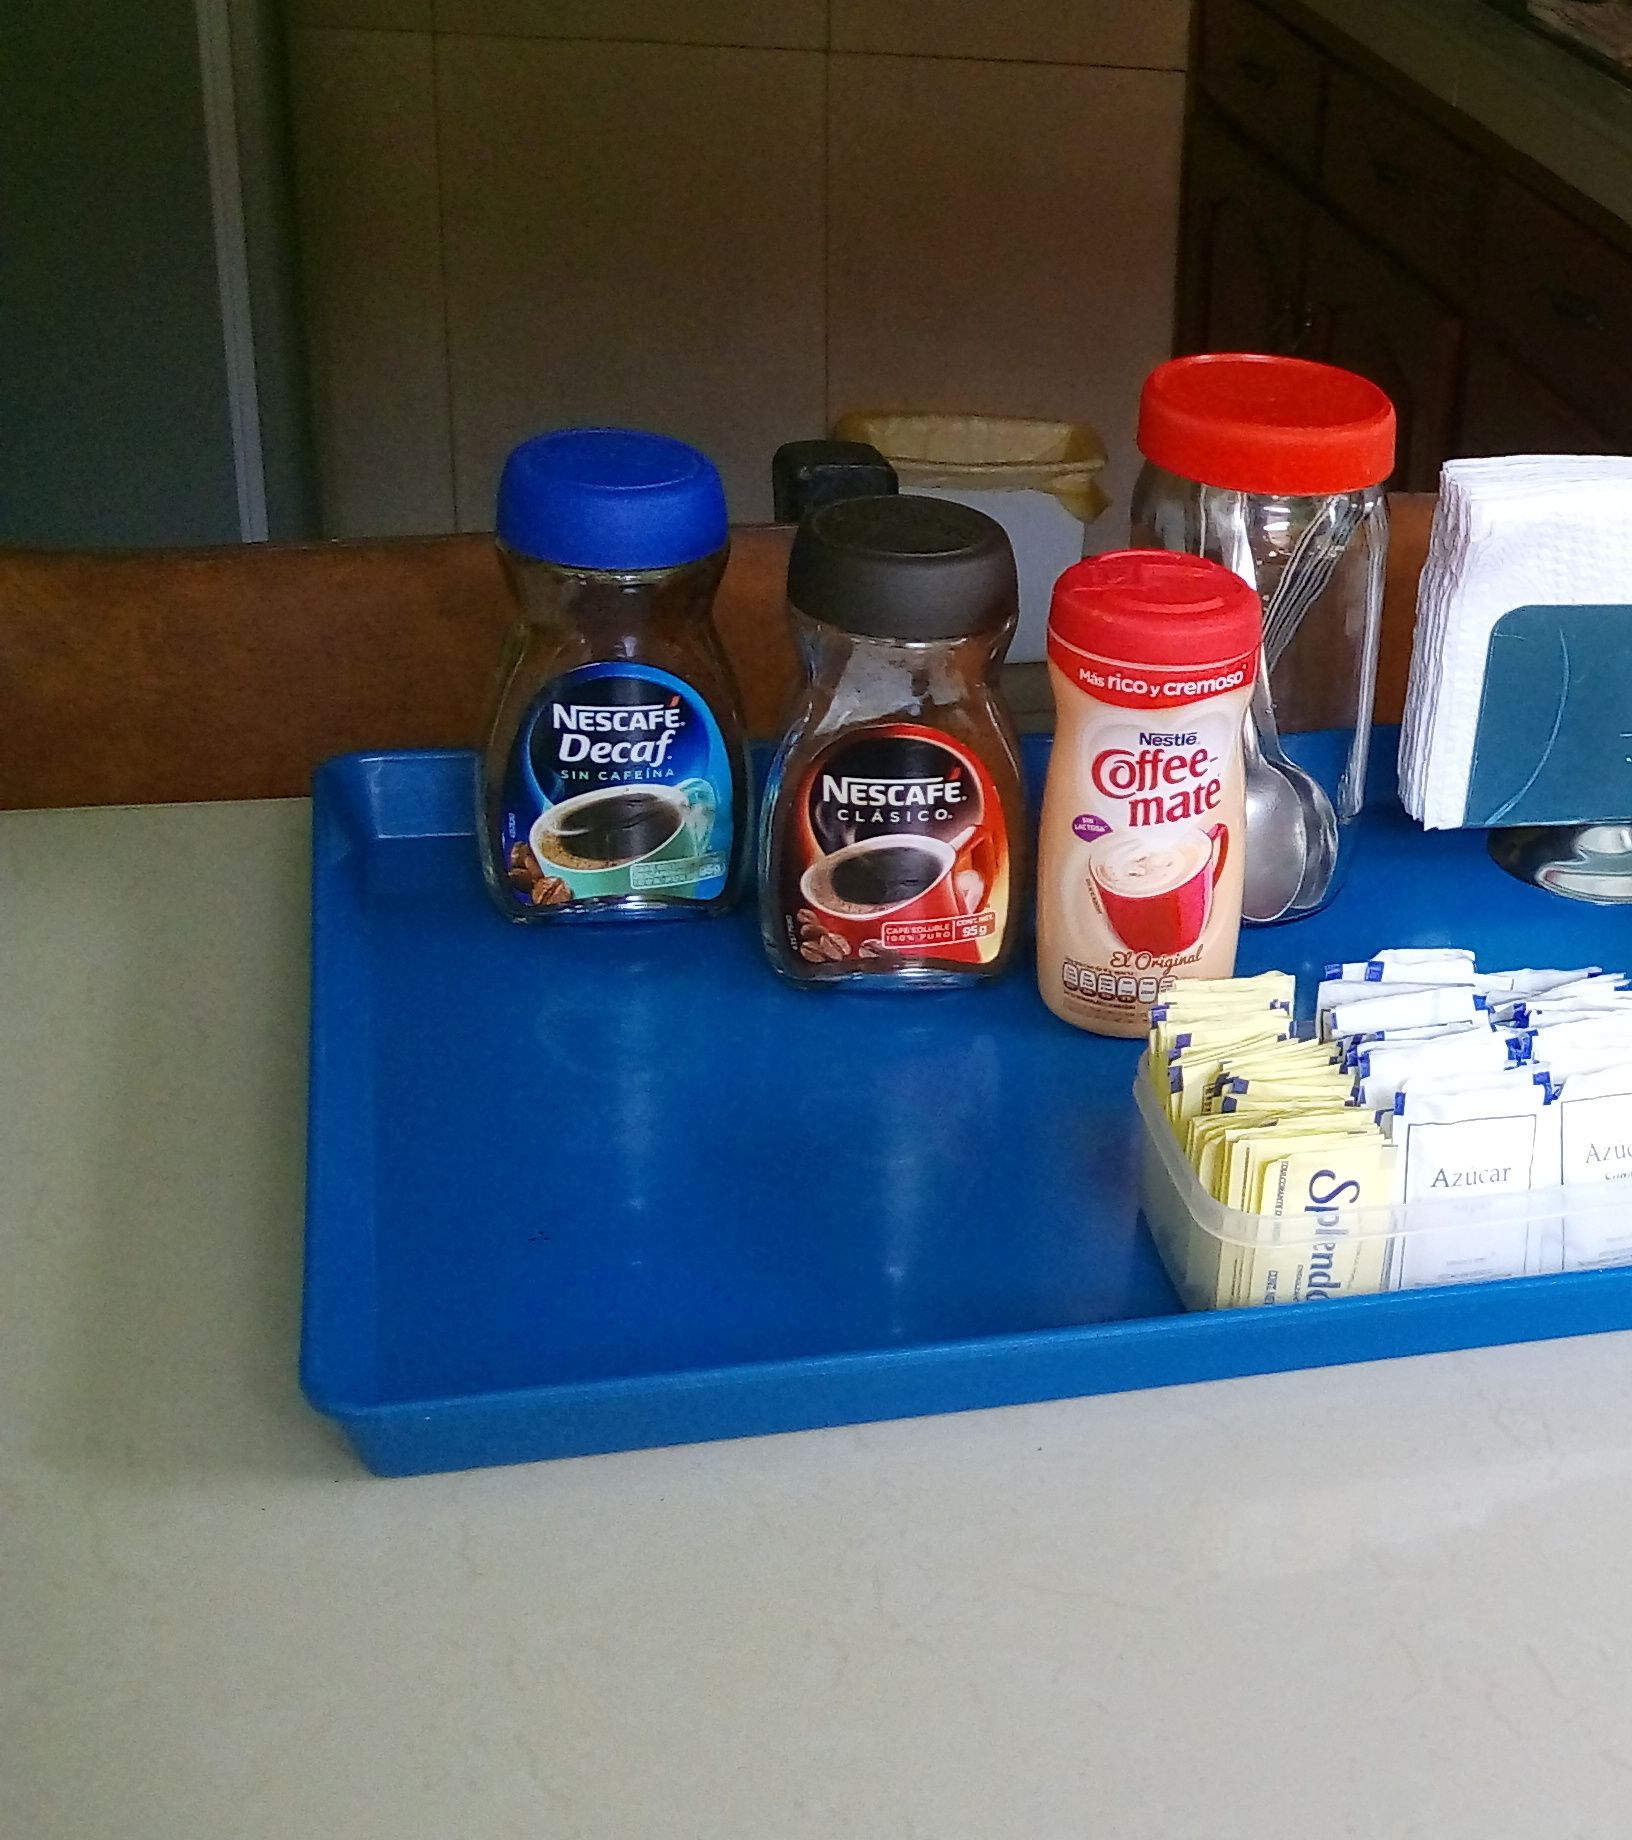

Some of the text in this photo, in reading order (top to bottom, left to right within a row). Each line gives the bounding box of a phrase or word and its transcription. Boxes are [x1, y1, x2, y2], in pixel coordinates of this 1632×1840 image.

[1079, 667, 1244, 698] Más rico y cremoso
[553, 695, 682, 732] NESCAFÉ
[558, 730, 676, 768] Decaf
[1139, 732, 1198, 746] Nestlé
[560, 767, 675, 782] SIN CAFEÍNA
[823, 767, 962, 807] NESCAFÉ
[837, 808, 950, 824] CLÁSICO
[1128, 778, 1222, 828] mate
[1110, 951, 1133, 968] El
[1134, 944, 1204, 975] Original
[1430, 1167, 1512, 1188] Azucar
